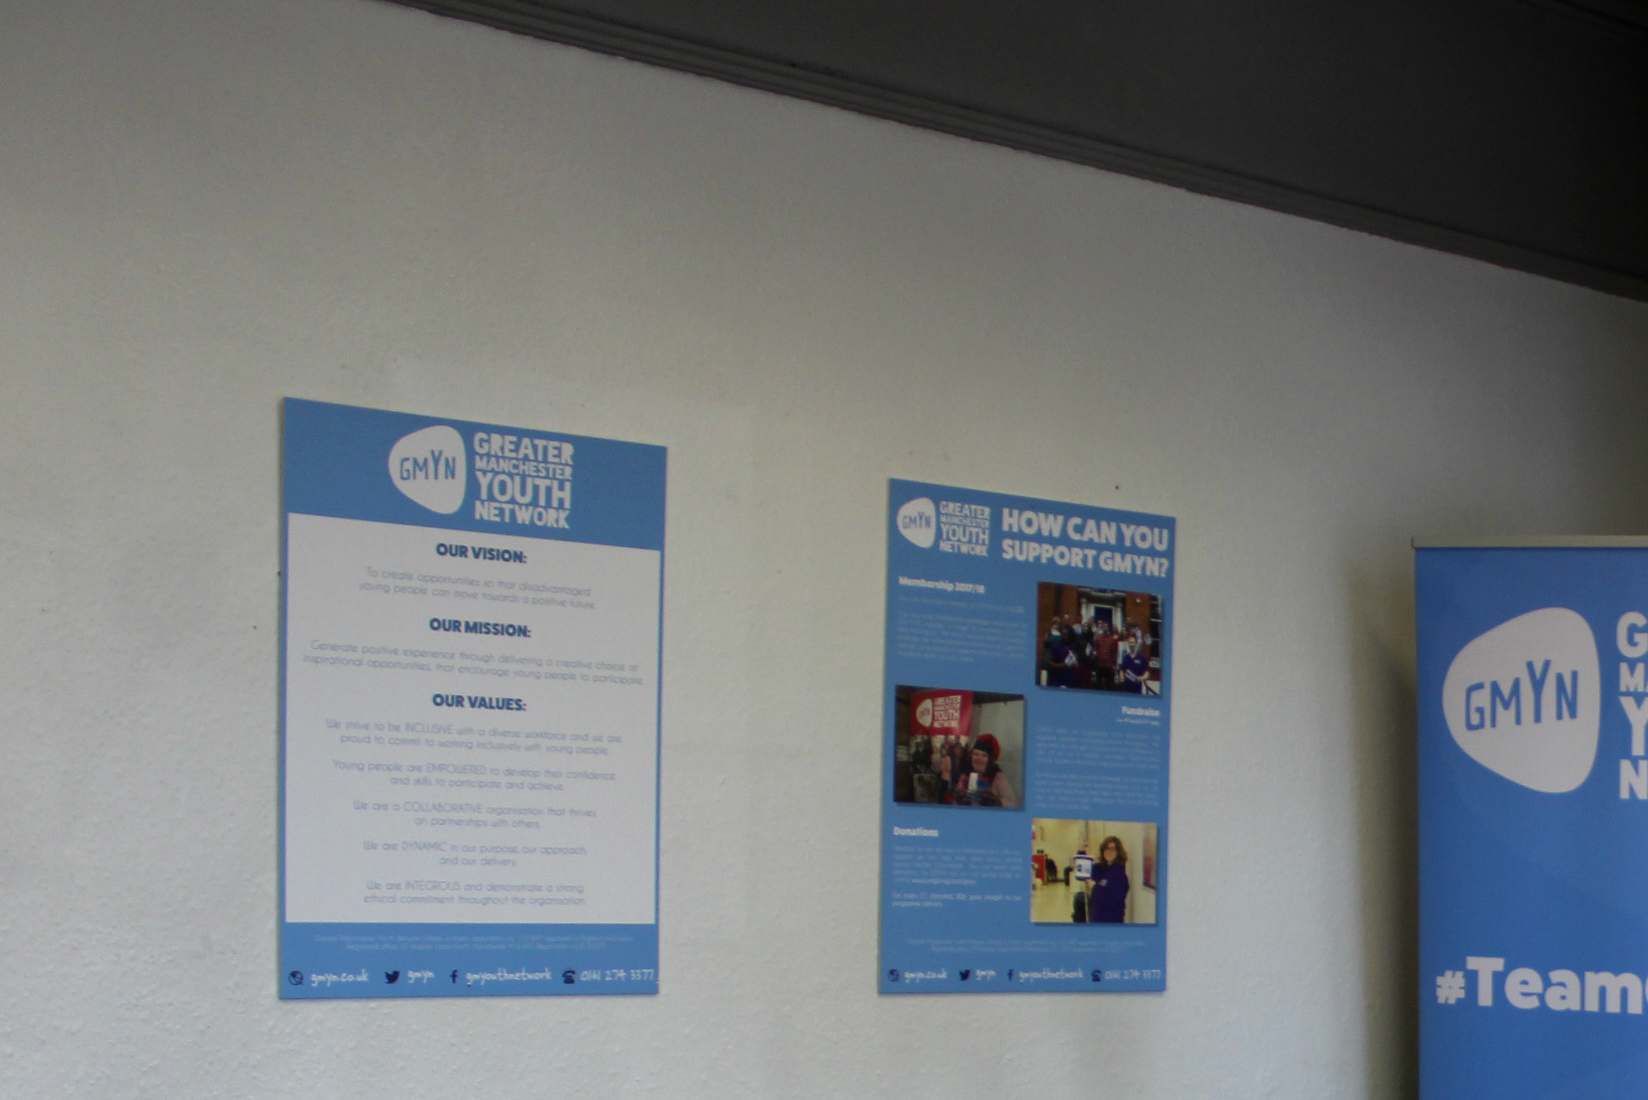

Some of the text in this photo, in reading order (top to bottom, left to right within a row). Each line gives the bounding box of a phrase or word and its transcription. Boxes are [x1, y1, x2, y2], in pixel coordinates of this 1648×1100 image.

[473, 432, 574, 465] GREATER
[400, 449, 456, 481] GMYN
[474, 456, 572, 480] MANCHESTER
[474, 473, 571, 509] YOUTH
[474, 500, 570, 529] NETWORK
[902, 511, 931, 530] GMYN
[939, 500, 991, 520] GREATER
[939, 524, 989, 545] YOUTH
[1002, 507, 1168, 551] HOW CAN YOU
[436, 542, 527, 564] OUR VISION:
[939, 541, 988, 557] NETWORK
[1002, 538, 1169, 578] SUPPORT GMYN?
[898, 576, 954, 591] Membership
[429, 617, 531, 638] OUR MISSION:
[432, 693, 526, 712] OUR VALUES:
[1464, 658, 1578, 731] GMYN
[893, 826, 938, 837] Donations
[310, 968, 369, 987] gmyn.co.uk
[407, 969, 434, 985] gmyn
[466, 967, 552, 987] gmyouthnetwork
